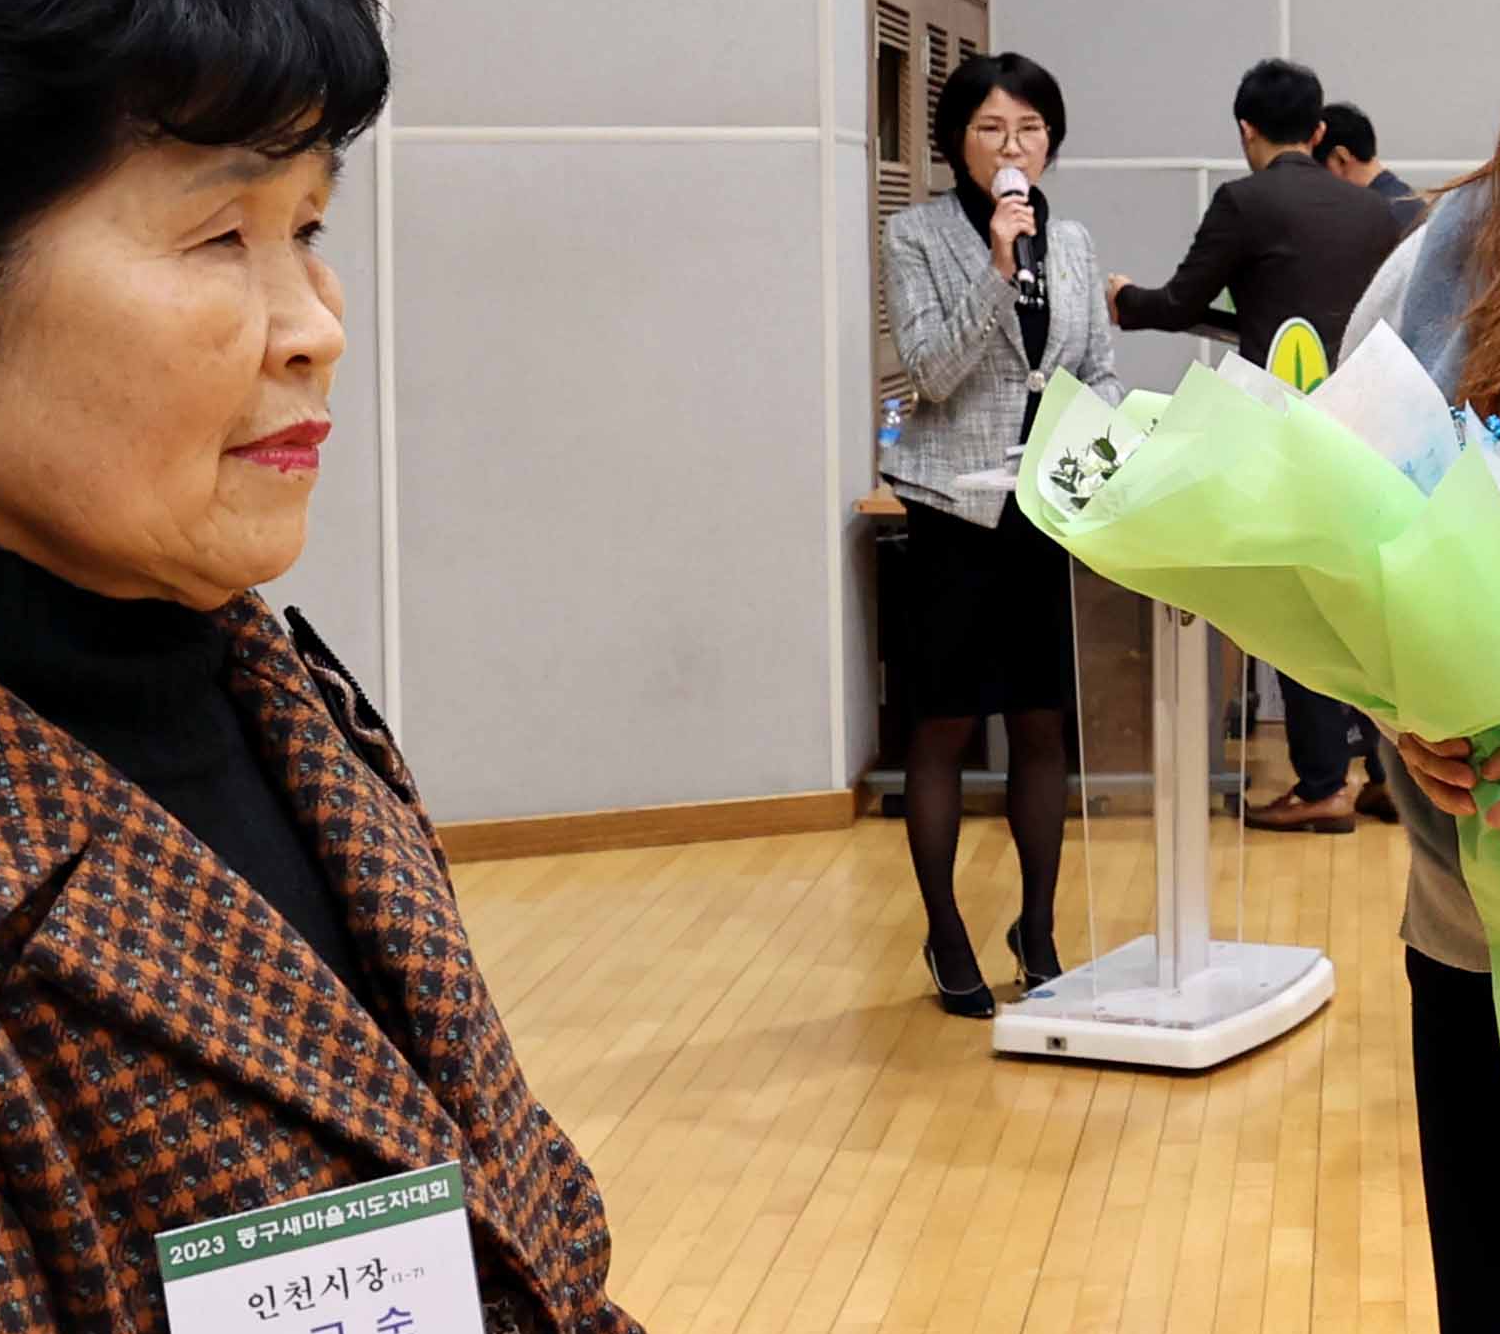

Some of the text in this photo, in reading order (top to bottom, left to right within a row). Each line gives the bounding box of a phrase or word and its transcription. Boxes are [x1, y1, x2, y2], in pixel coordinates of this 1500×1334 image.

[169, 1178, 450, 1264] 2023 동구새마을지도자대회
[248, 1257, 388, 1320] 인천시장
